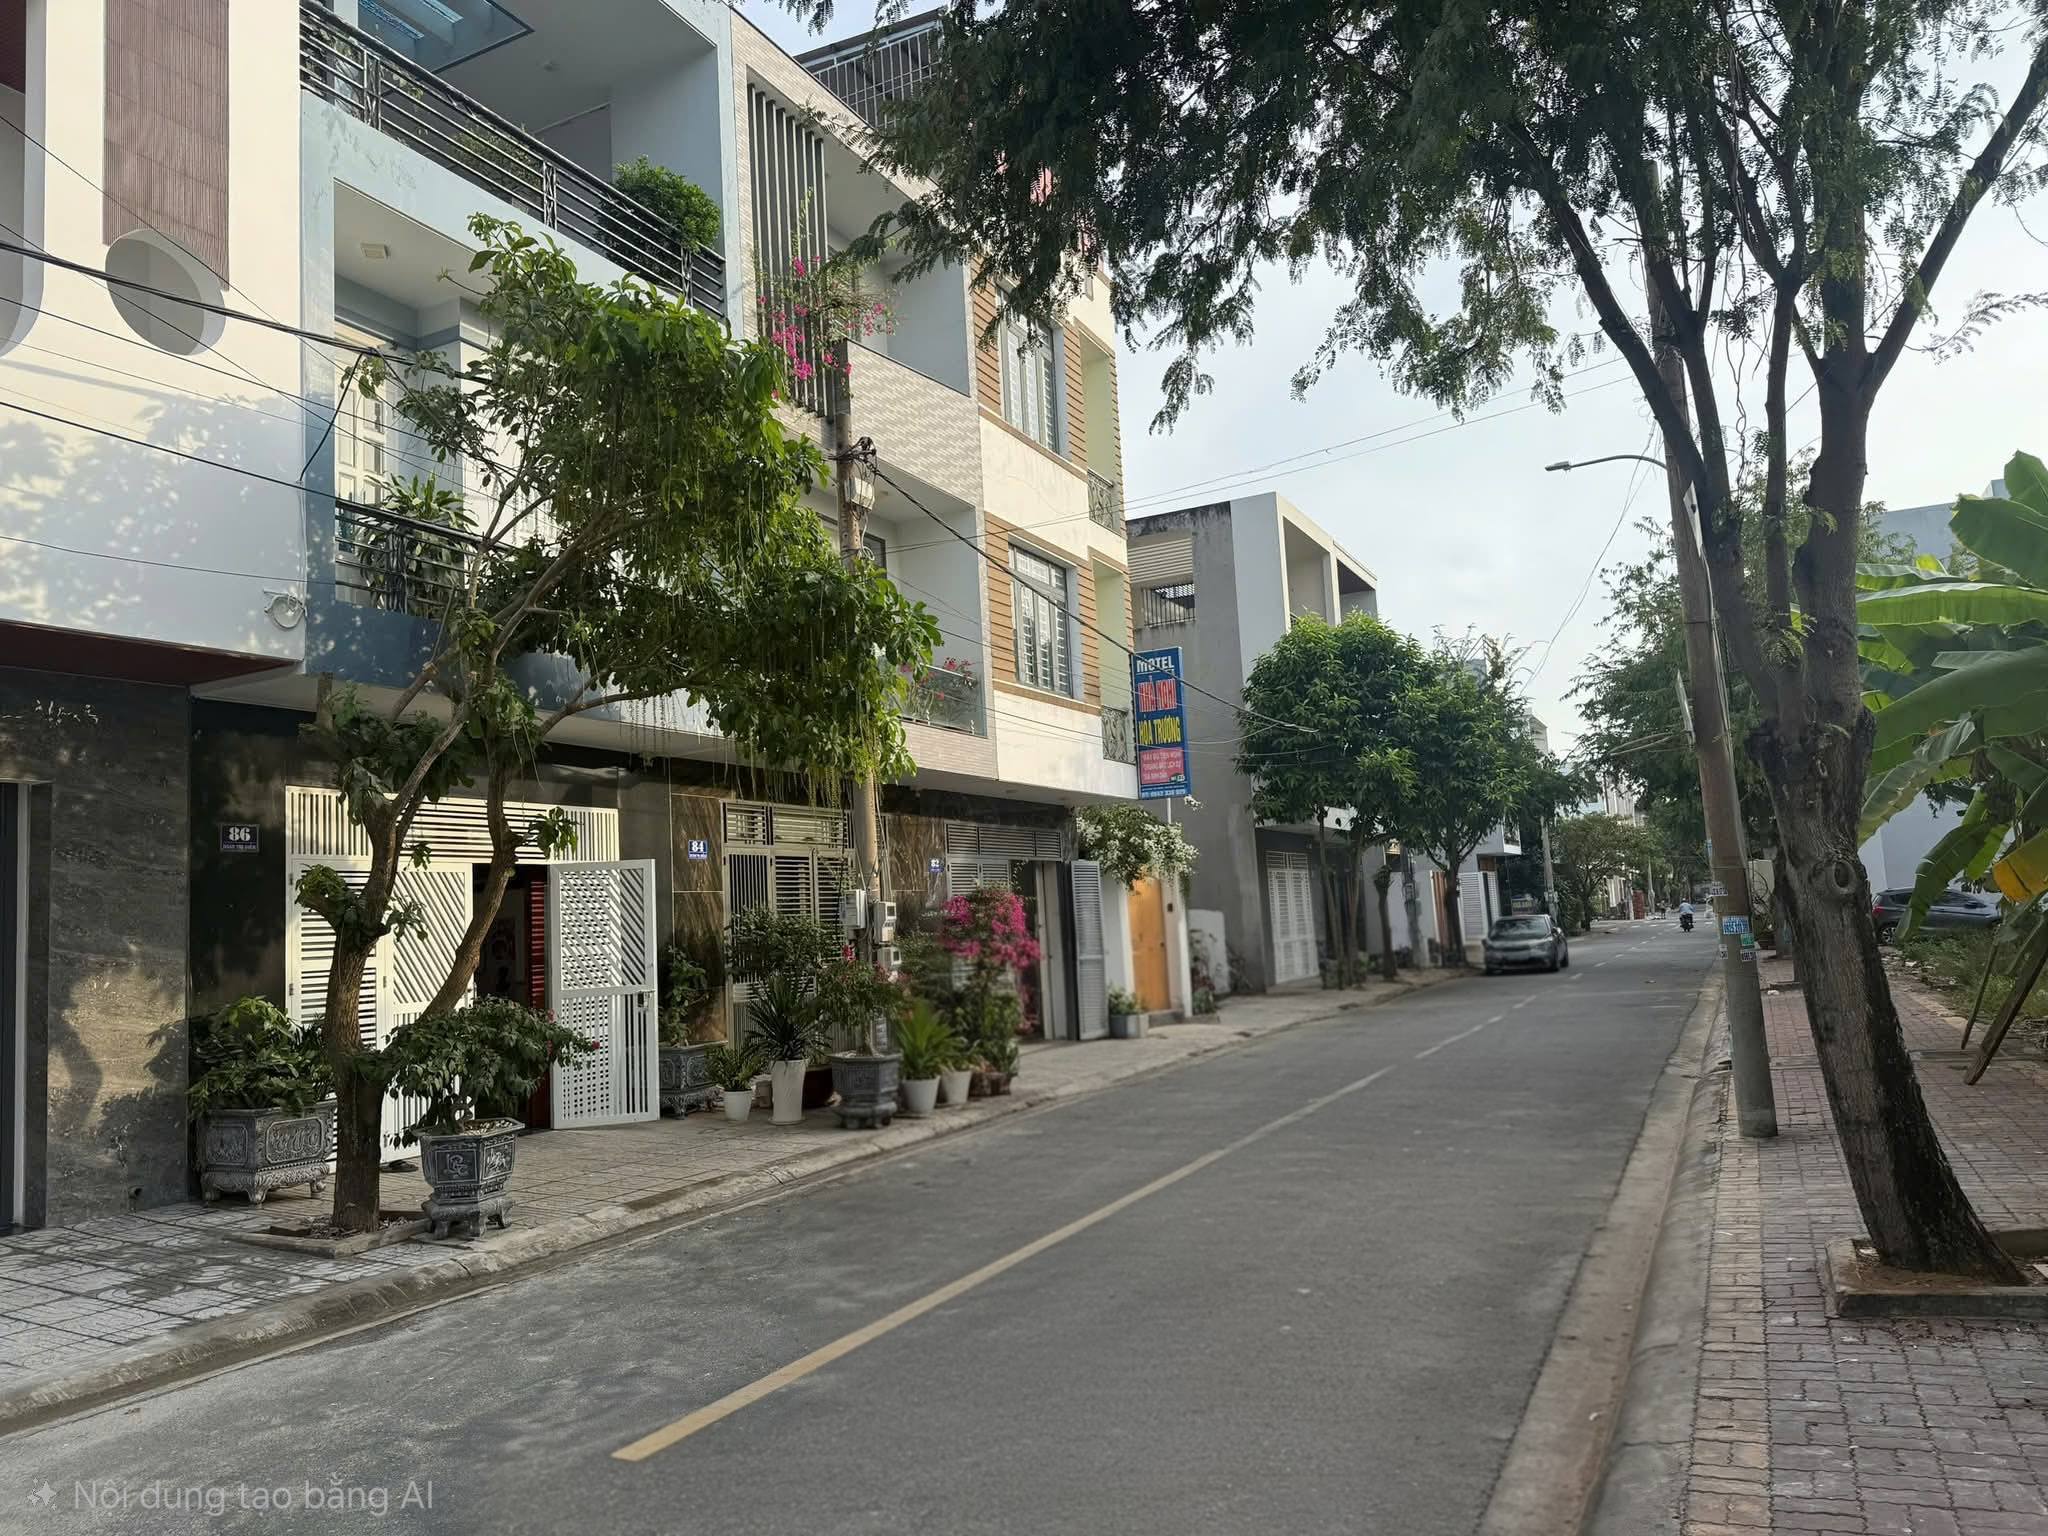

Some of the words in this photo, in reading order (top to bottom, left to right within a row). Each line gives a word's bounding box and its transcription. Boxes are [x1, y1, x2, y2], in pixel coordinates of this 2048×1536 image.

[1136, 656, 1175, 672] MOTEL
[229, 826, 250, 841] 86
[692, 841, 704, 852] 84
